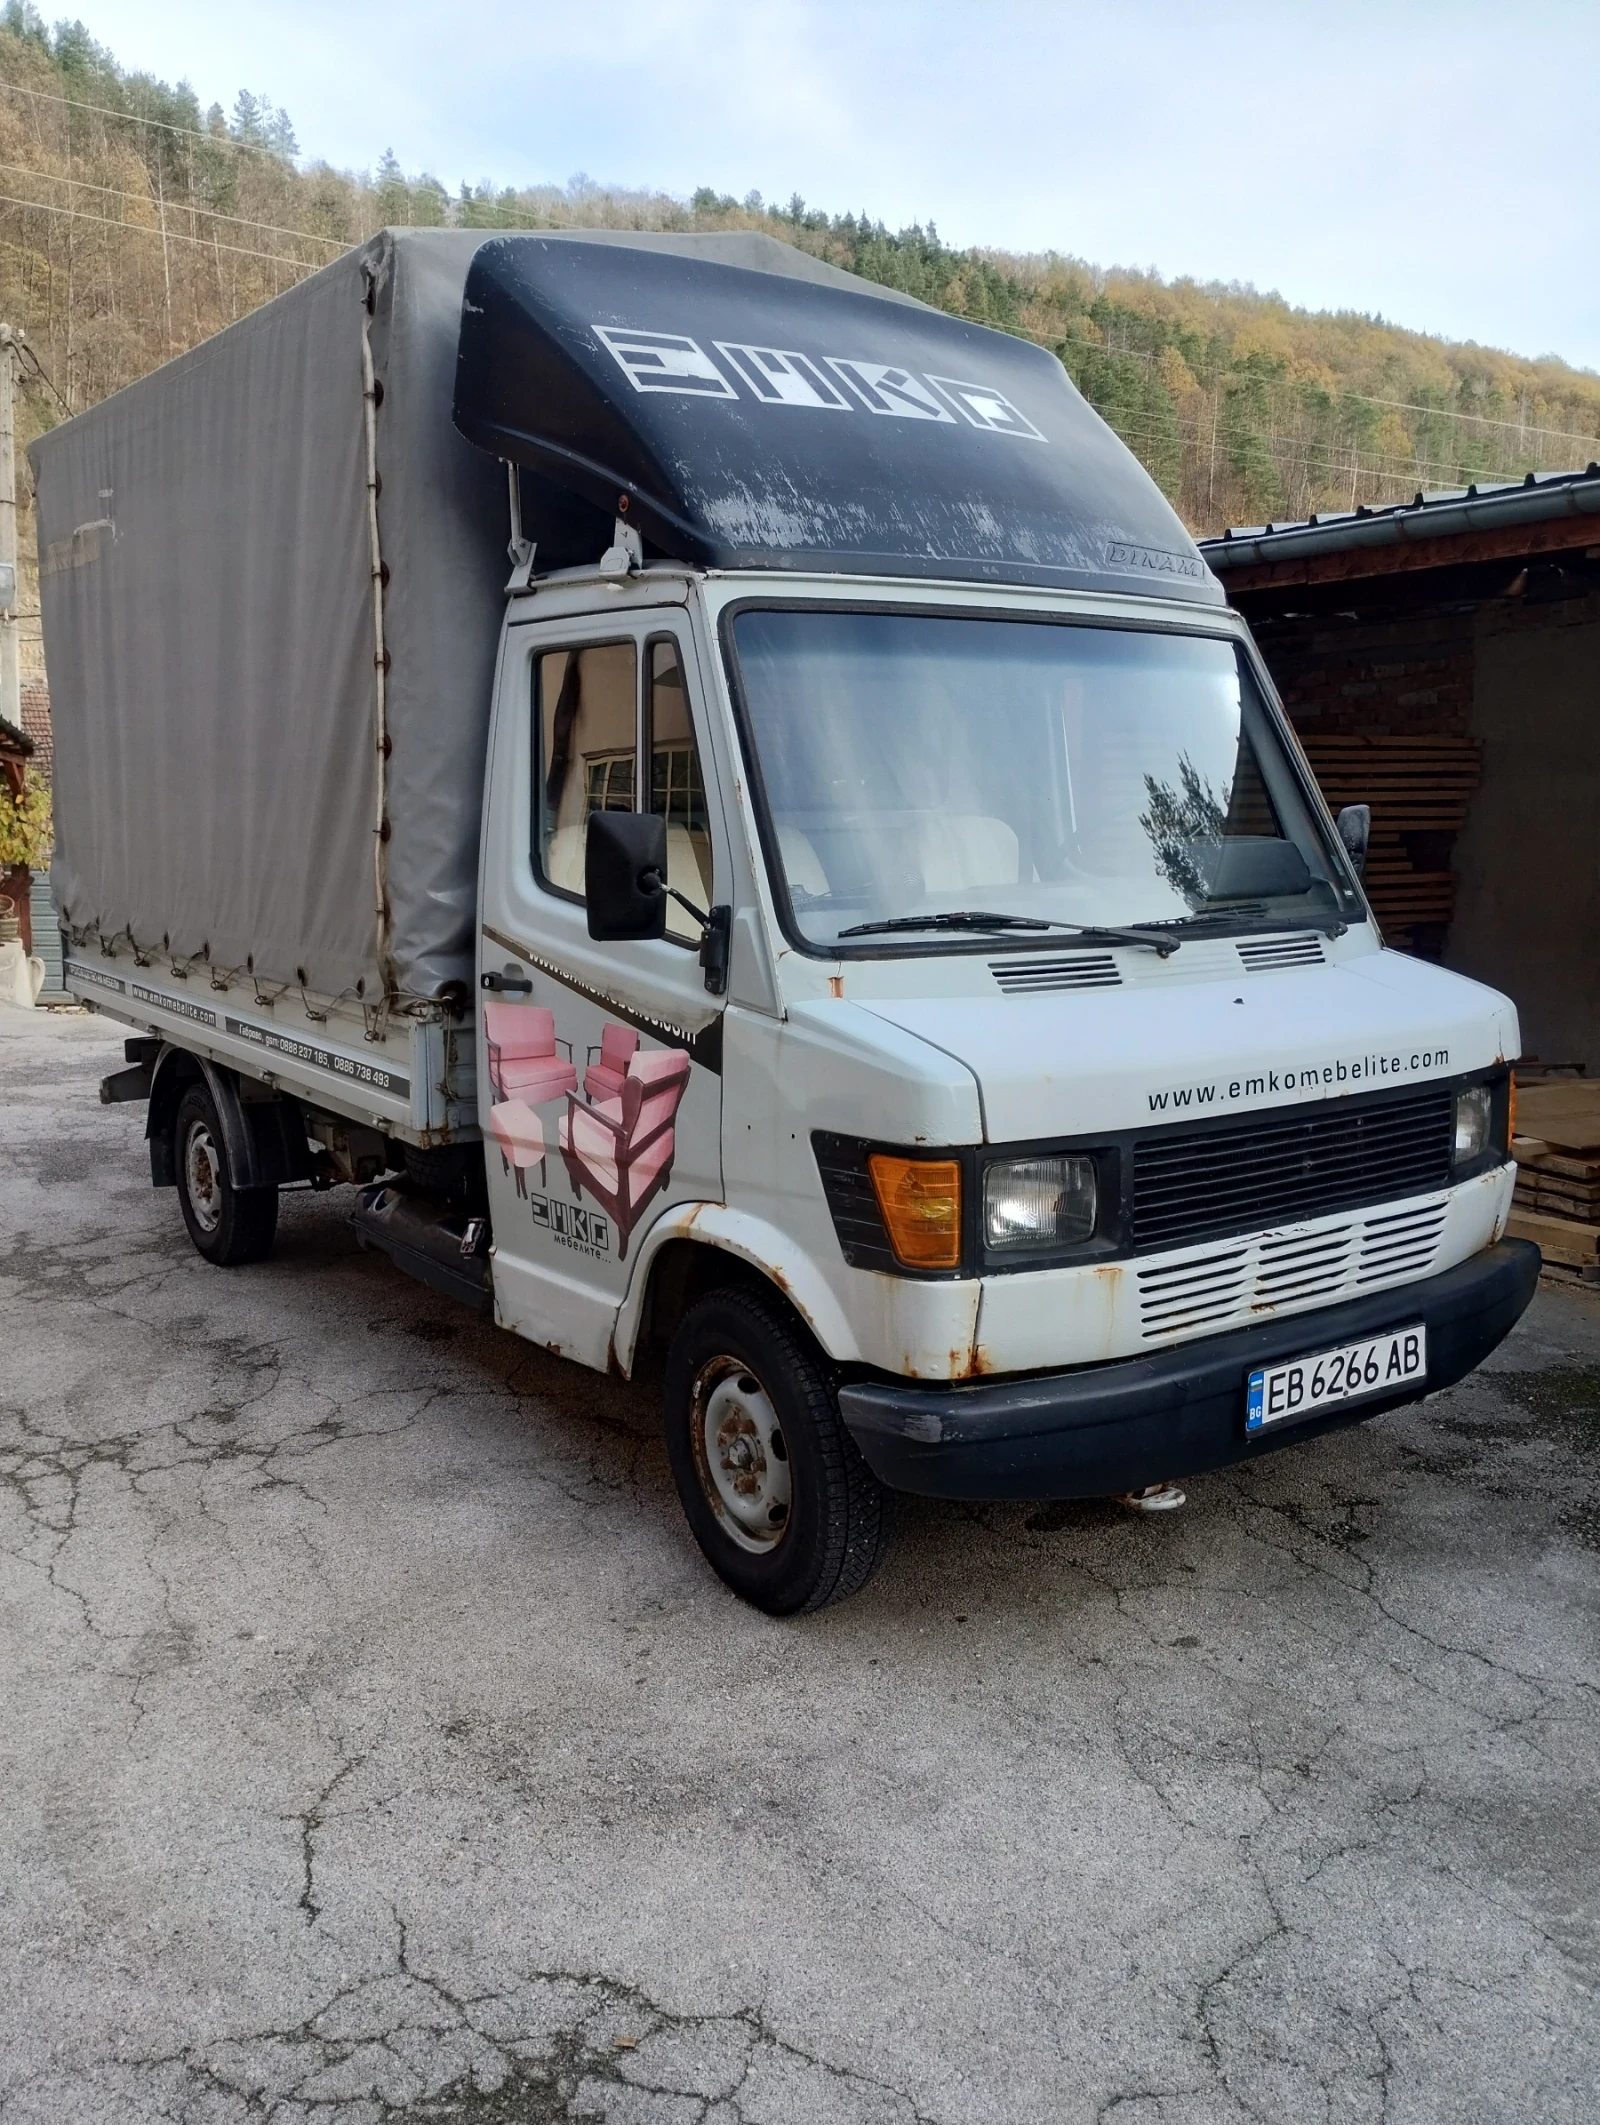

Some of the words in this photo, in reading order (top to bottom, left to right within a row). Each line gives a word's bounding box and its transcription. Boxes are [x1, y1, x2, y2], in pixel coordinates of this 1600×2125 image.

[132, 988, 216, 1024] www.emkomebelite.com
[298, 1045, 312, 1060] 237
[334, 1056, 354, 1075] 0886
[356, 1064, 372, 1081] 738
[372, 1071, 390, 1088] 493
[1148, 1048, 1450, 1111] www.emkomebelite.com
[1267, 1367, 1304, 1416] EB
[1311, 1344, 1379, 1399] 6266
[1385, 1334, 1420, 1380] AB
[1249, 1405, 1262, 1420] BG
